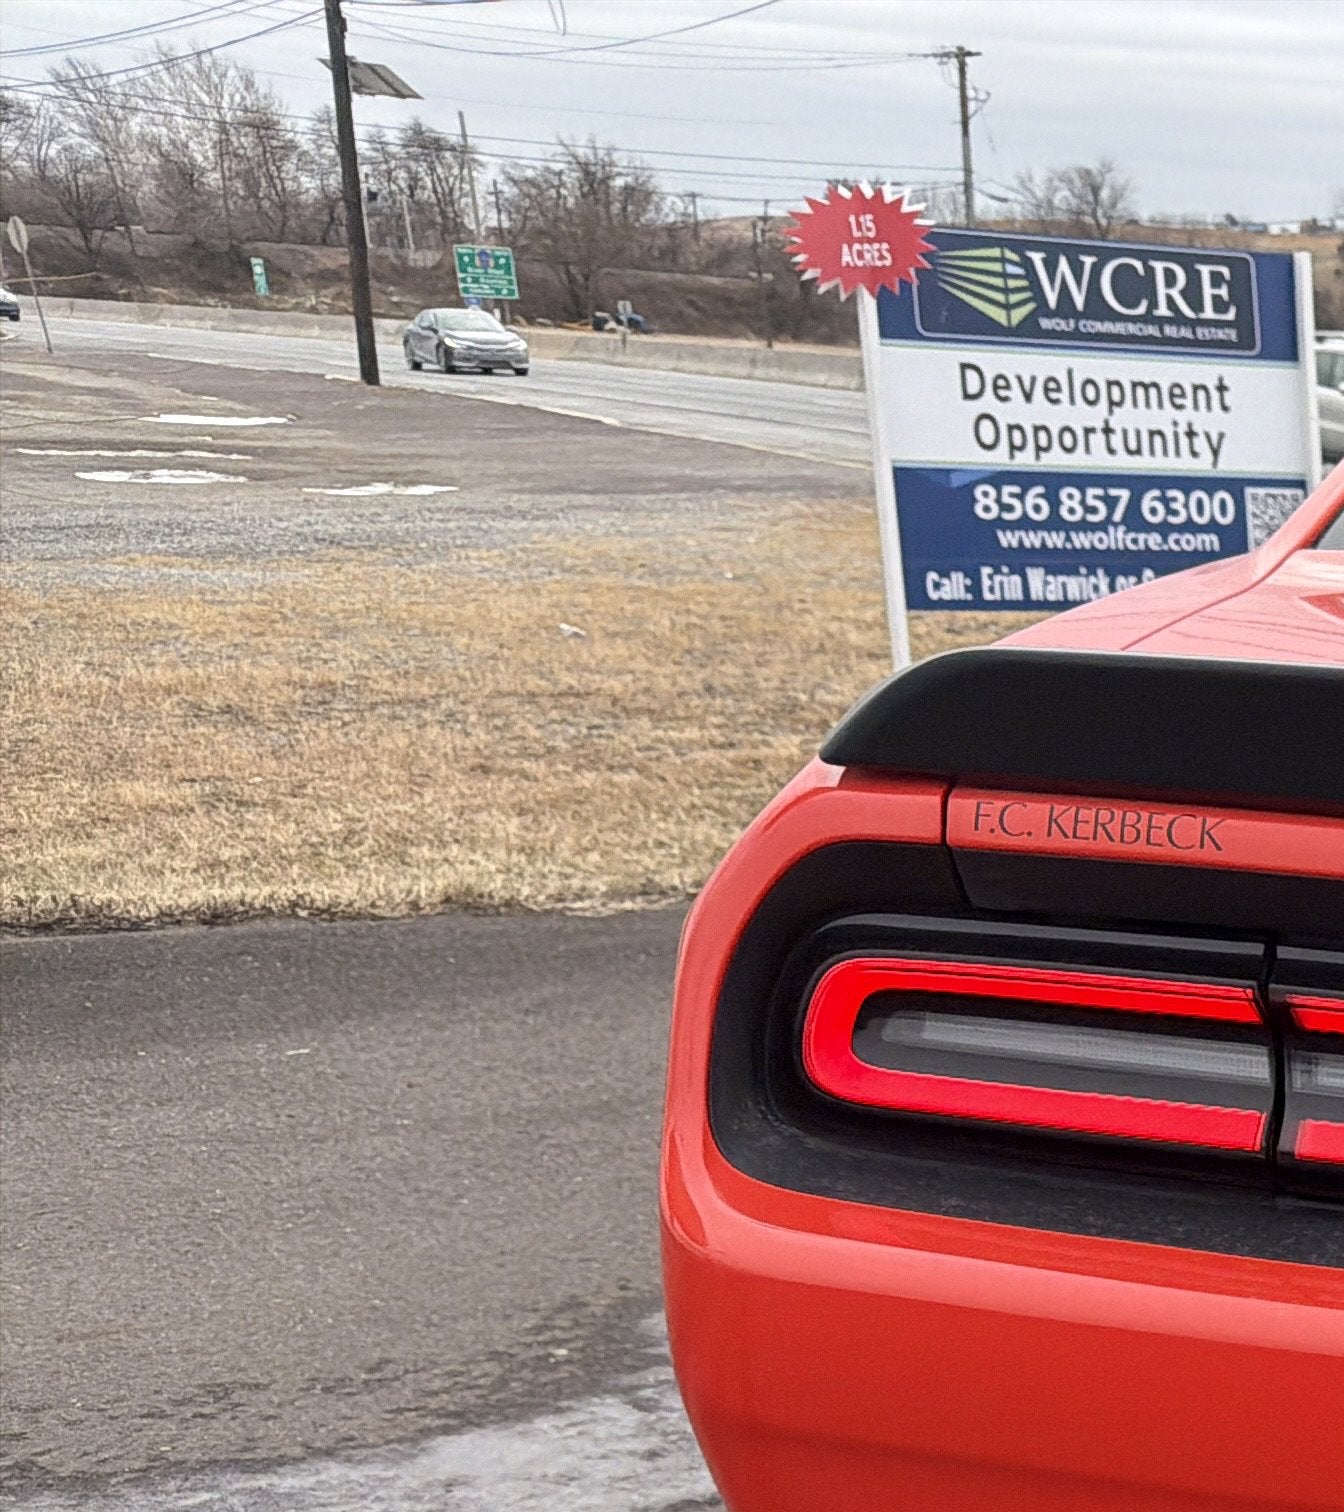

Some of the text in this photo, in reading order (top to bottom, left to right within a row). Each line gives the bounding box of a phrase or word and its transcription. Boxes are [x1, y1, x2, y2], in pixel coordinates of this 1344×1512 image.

[841, 242, 893, 267] ACRES
[1025, 250, 1237, 321] WCRE
[1037, 316, 1239, 343] WOLF COMMERCIAL REAL ESTATE
[959, 361, 1231, 417] Development
[973, 412, 1226, 468] Opportunity
[973, 484, 1236, 526] 856 857 6300
[996, 525, 1221, 553] www.wolfcre.com
[925, 570, 973, 601] Call:
[980, 565, 1023, 602] Erin
[1025, 565, 1110, 602] Warwick
[973, 800, 1227, 852] F.C. KERBECK
